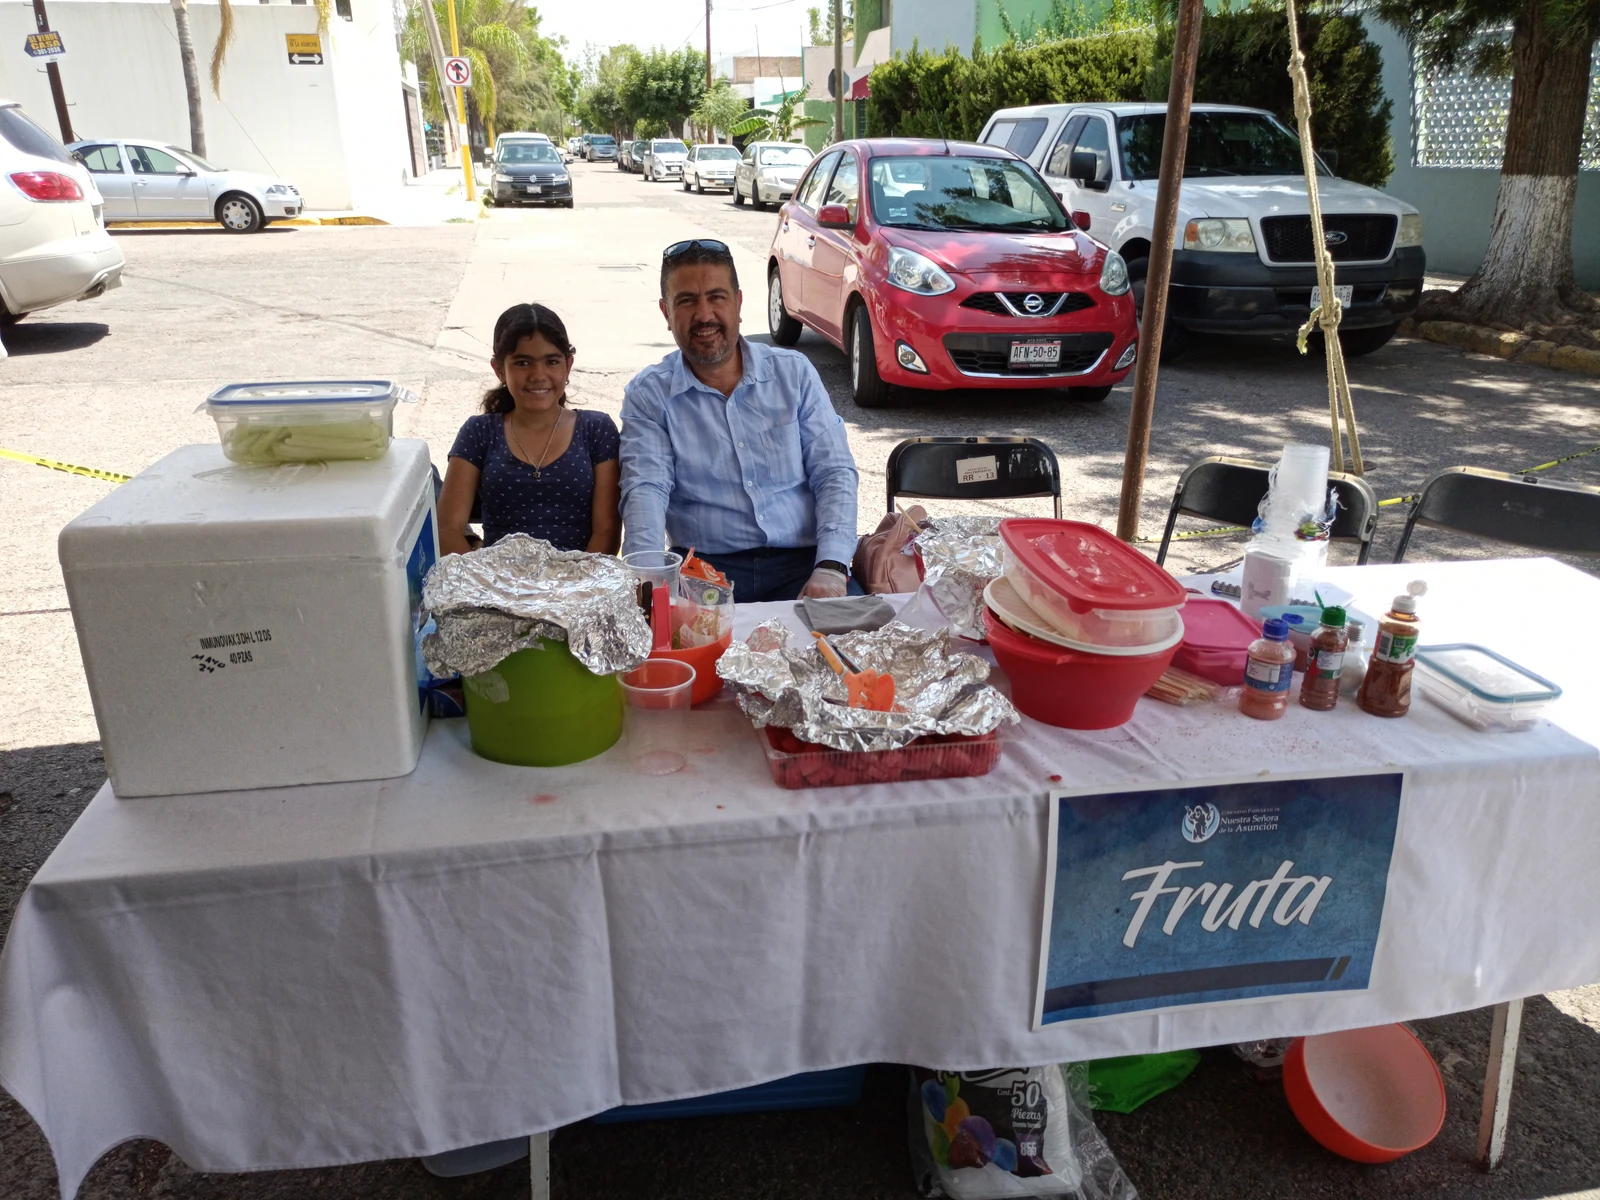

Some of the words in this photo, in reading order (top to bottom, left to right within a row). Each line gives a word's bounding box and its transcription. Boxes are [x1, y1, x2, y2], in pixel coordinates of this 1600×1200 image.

[37, 33, 58, 42] VENDE
[31, 40, 61, 50] CASA
[1013, 346, 1058, 359] AFN-50-85
[200, 634, 237, 650] INMUNOVAX
[236, 633, 241, 645] 3
[255, 630, 264, 642] 12
[262, 628, 272, 640] DS
[192, 654, 226, 668] MAYO
[230, 653, 238, 664] 40
[238, 650, 253, 664] PZAS
[199, 664, 214, 673] 24
[1220, 816, 1250, 824] Nuestra
[1252, 814, 1279, 822] Señora
[1235, 822, 1278, 832] Asunción
[1121, 860, 1333, 948] Fruta
[1010, 1082, 1041, 1108] 50
[1012, 1108, 1041, 1120] Piezas
